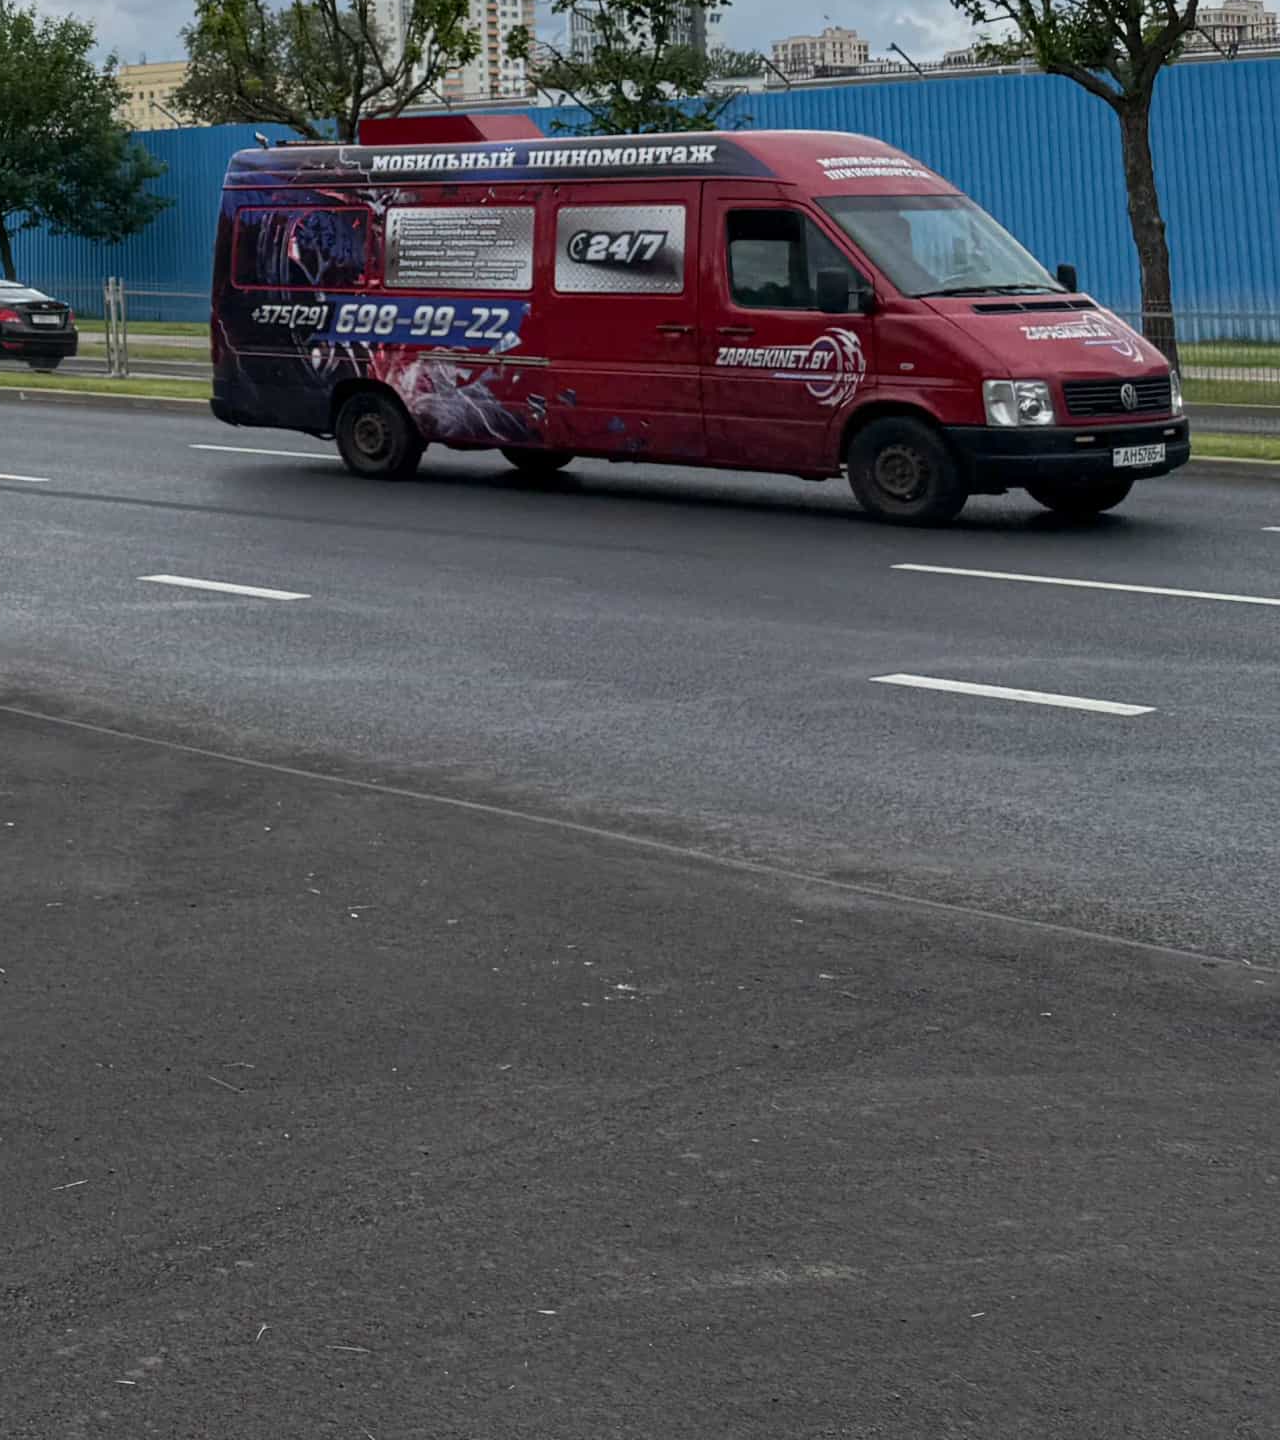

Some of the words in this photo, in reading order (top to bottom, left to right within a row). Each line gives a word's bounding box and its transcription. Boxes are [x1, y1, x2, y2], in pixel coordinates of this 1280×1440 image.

[371, 147, 516, 172] МОБИЛЬНЫЙ
[585, 232, 666, 264] 24/7
[335, 304, 510, 339] 698-99-22
[715, 347, 835, 370] ZAPASKINET.BY
